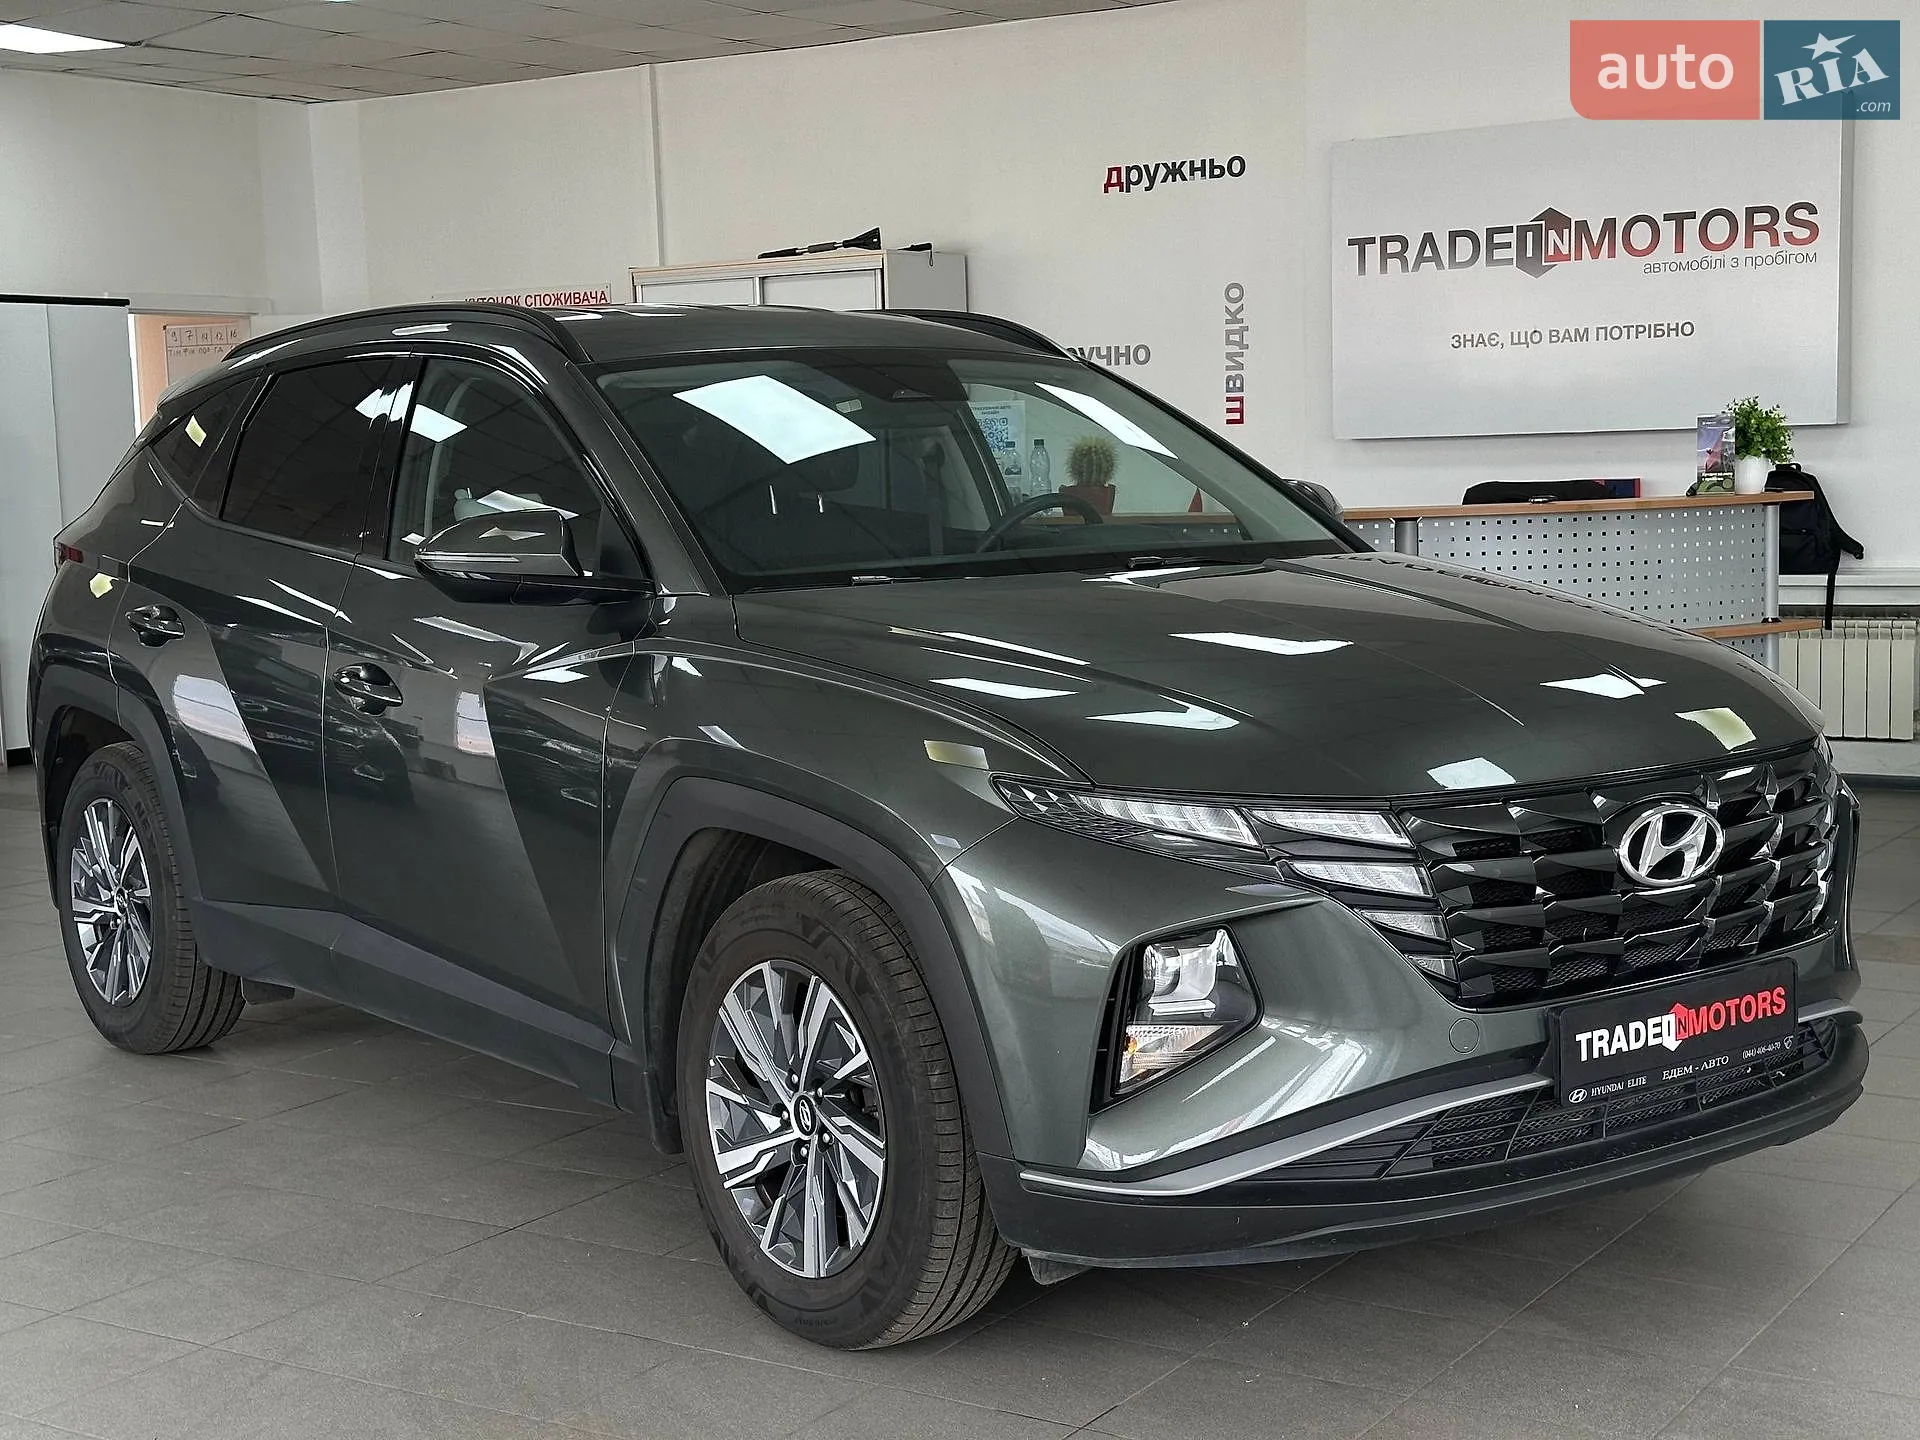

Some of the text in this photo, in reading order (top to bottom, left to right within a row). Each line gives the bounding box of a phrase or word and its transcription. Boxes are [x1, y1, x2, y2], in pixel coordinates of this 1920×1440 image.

[1103, 155, 1247, 194] дружньо
[1643, 251, 1818, 274] автомобілі з пробігом
[525, 290, 608, 308] СПОЖИВАЧА
[1451, 321, 1695, 350] ЗНАЄ, ЩО ВАМ ПОТРІБНО
[1661, 1064, 1693, 1081] ЕДЕМ
[1701, 1055, 1729, 1071] АВТО
[1591, 1076, 1647, 1097] HYUNDAI ELITE
